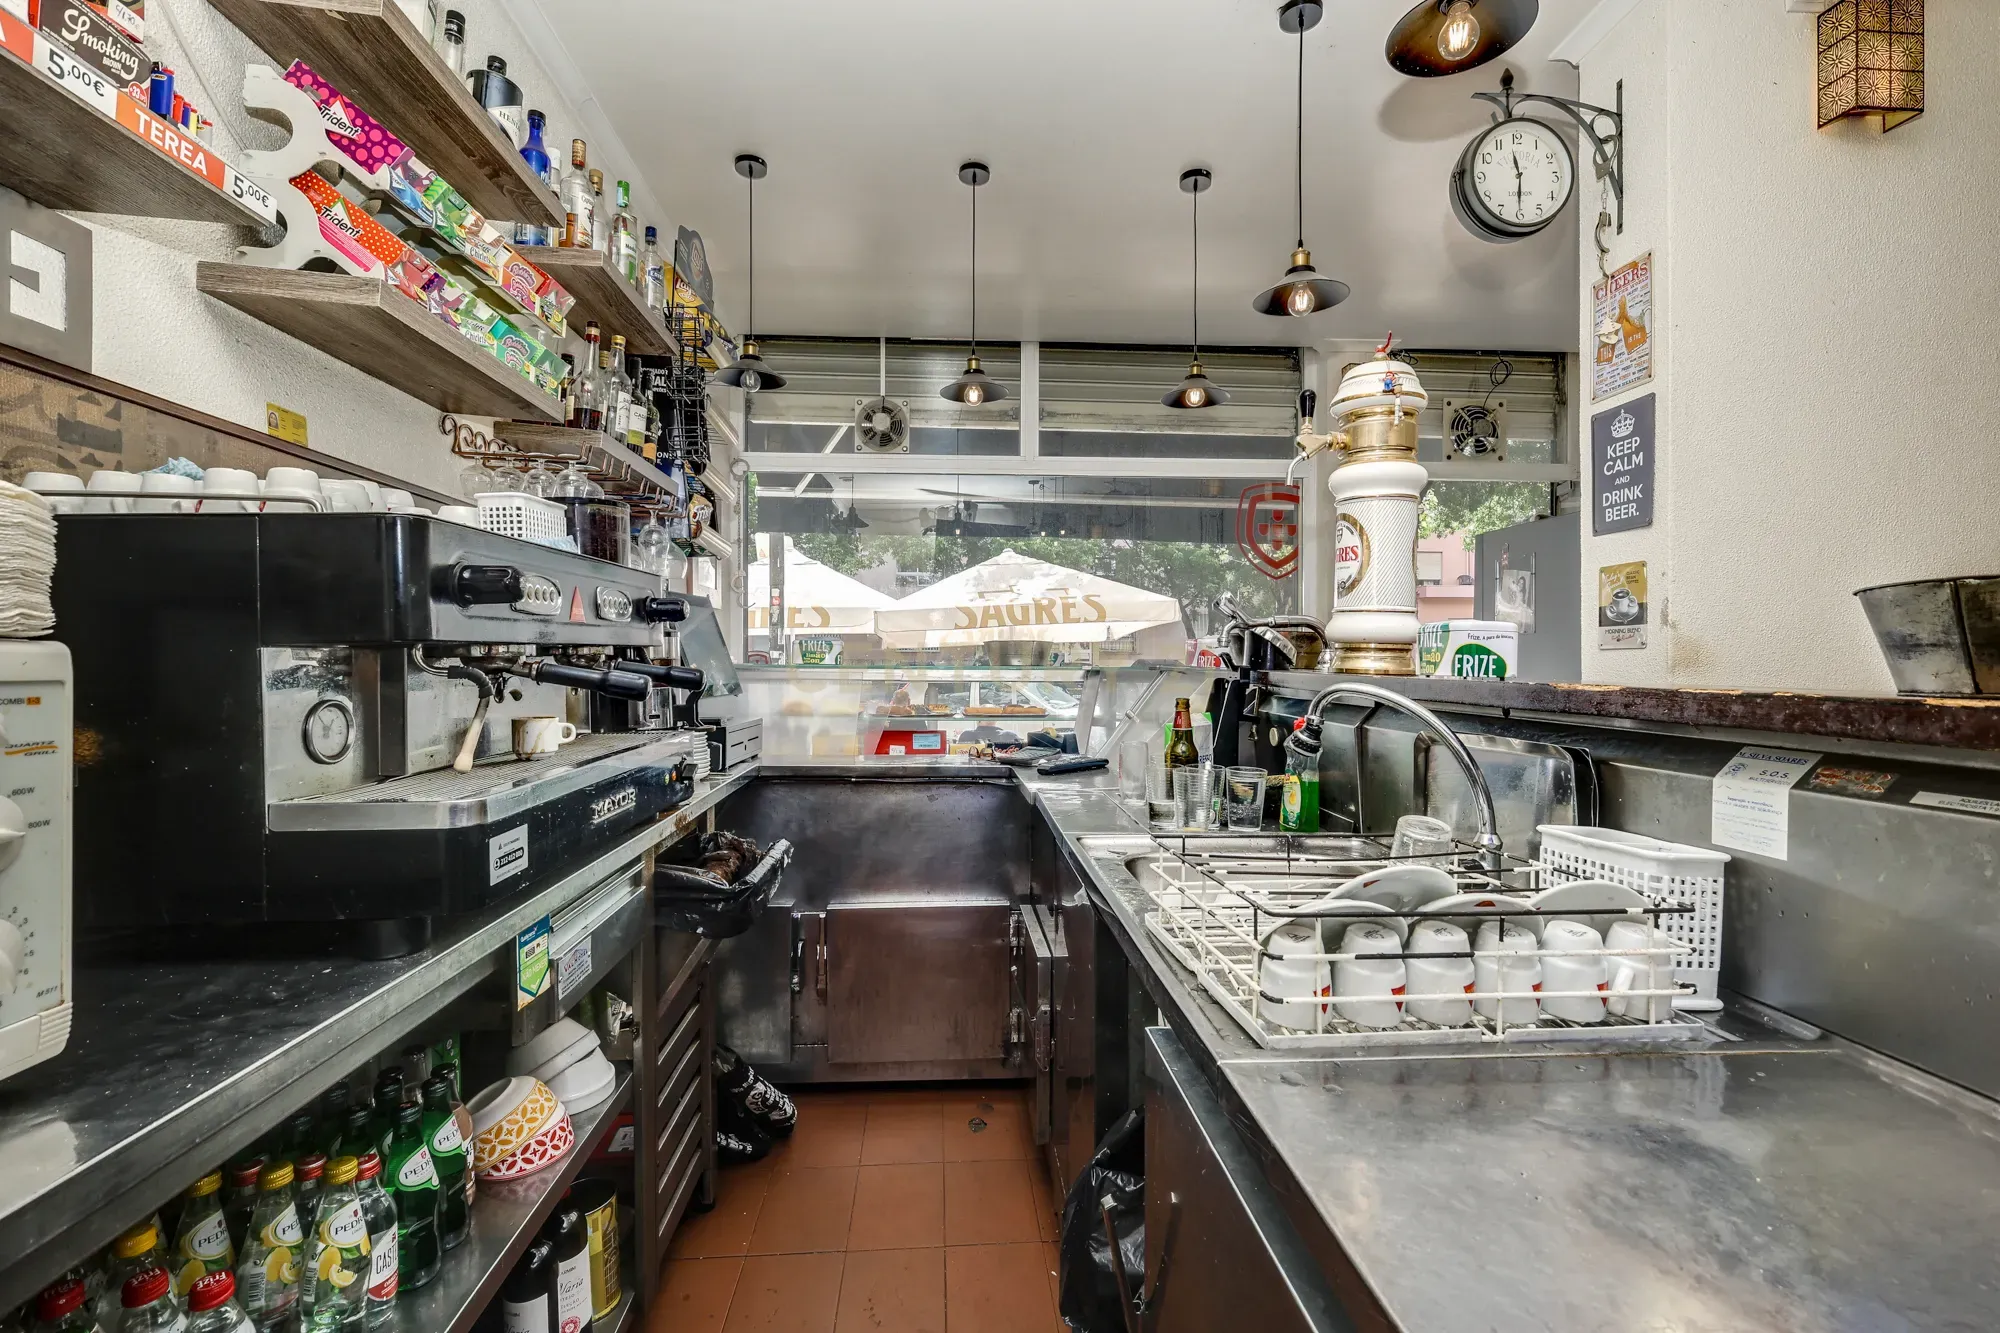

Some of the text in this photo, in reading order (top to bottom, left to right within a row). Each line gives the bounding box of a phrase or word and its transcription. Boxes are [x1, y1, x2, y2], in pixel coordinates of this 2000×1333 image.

[61, 8, 139, 80] Smoking
[102, 56, 122, 71] BROWN
[47, 48, 105, 97] 5,00€
[320, 104, 360, 137] Trident
[134, 107, 207, 176] TEREA
[1495, 139, 1503, 151] 11
[1512, 133, 1523, 145] 12
[1534, 139, 1538, 151] 1
[1481, 152, 1493, 165] 10
[1545, 152, 1554, 165] 2
[1476, 171, 1487, 184] 9
[1551, 171, 1560, 184] 3
[233, 174, 270, 208] 5,00€
[1483, 190, 1492, 202] 8
[1546, 190, 1557, 201] 4
[1497, 204, 1505, 216] 7
[1515, 208, 1525, 221] 6
[1535, 203, 1543, 217] 5
[320, 206, 361, 237] Trident
[1607, 436, 1641, 459] KEEP
[1603, 451, 1644, 476] CALM
[1614, 475, 1630, 486] AND
[1602, 484, 1643, 507] DRINK
[1605, 503, 1640, 522] BEER.
[803, 640, 828, 652] FRIZE
[1454, 654, 1498, 678] FRIZE
[1749, 752, 1772, 760] SILVA
[1772, 755, 1809, 765] SOARES
[1759, 769, 1790, 779] S.O.S.
[11, 786, 36, 797] 600W
[27, 819, 51, 829] 800W
[12, 906, 18, 914] 2
[23, 917, 29, 925] 3
[29, 949, 35, 957] 5
[23, 967, 29, 975] 6
